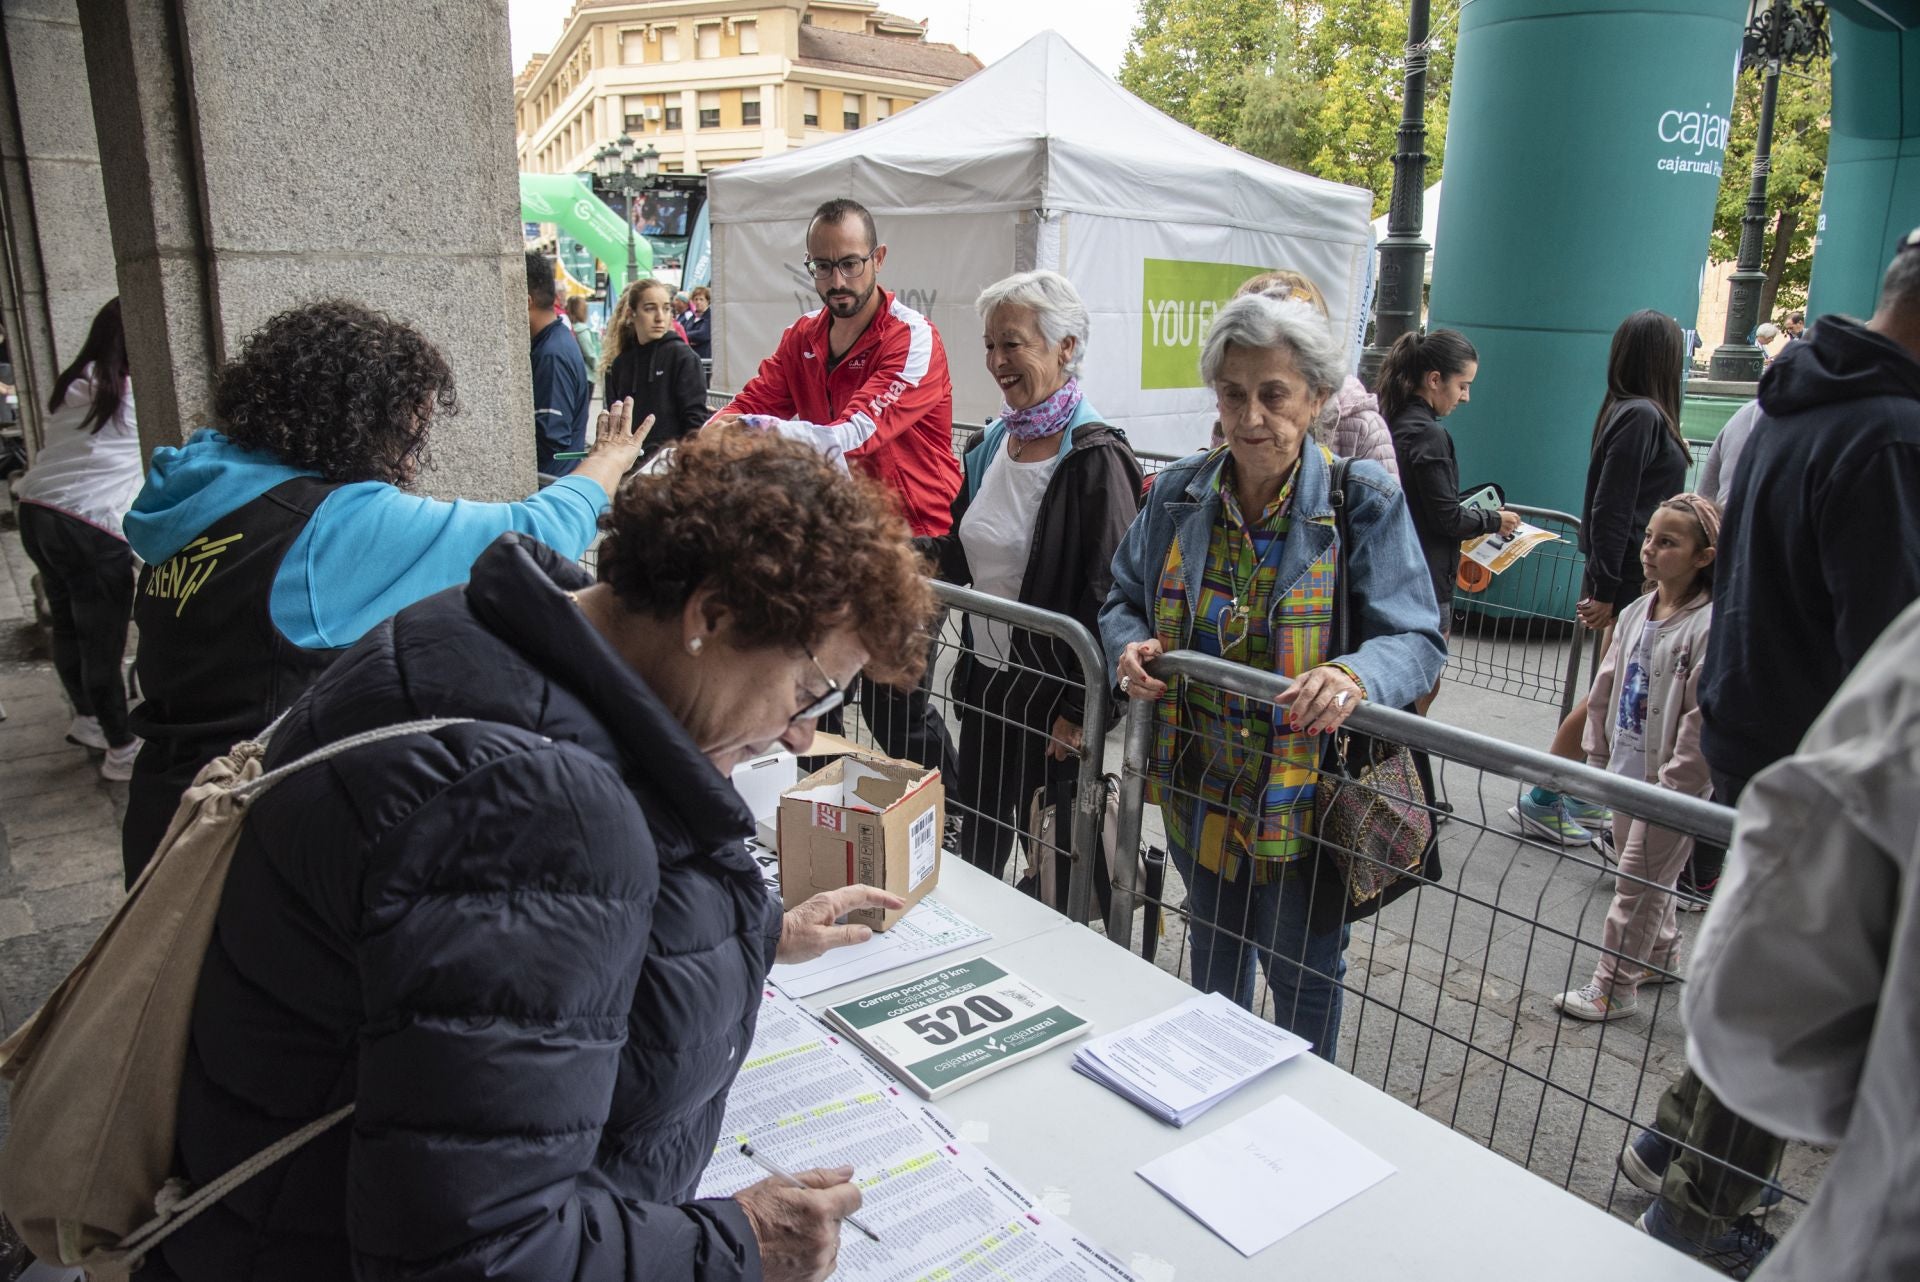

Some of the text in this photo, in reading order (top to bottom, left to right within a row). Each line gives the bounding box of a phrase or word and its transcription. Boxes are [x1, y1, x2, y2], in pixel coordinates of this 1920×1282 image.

[1657, 156, 1713, 175] cajarural
[1148, 299, 1195, 347] YOU
[858, 990, 901, 1009] Carrera
[900, 976, 941, 997] popular
[940, 972, 950, 981] 9
[897, 982, 951, 1006] cajarural
[887, 1000, 927, 1018] CONTRA
[926, 995, 939, 1005] EL
[904, 994, 1014, 1046] 520
[1003, 1017, 1058, 1044] cajarural
[934, 1047, 987, 1073] cajaviva
